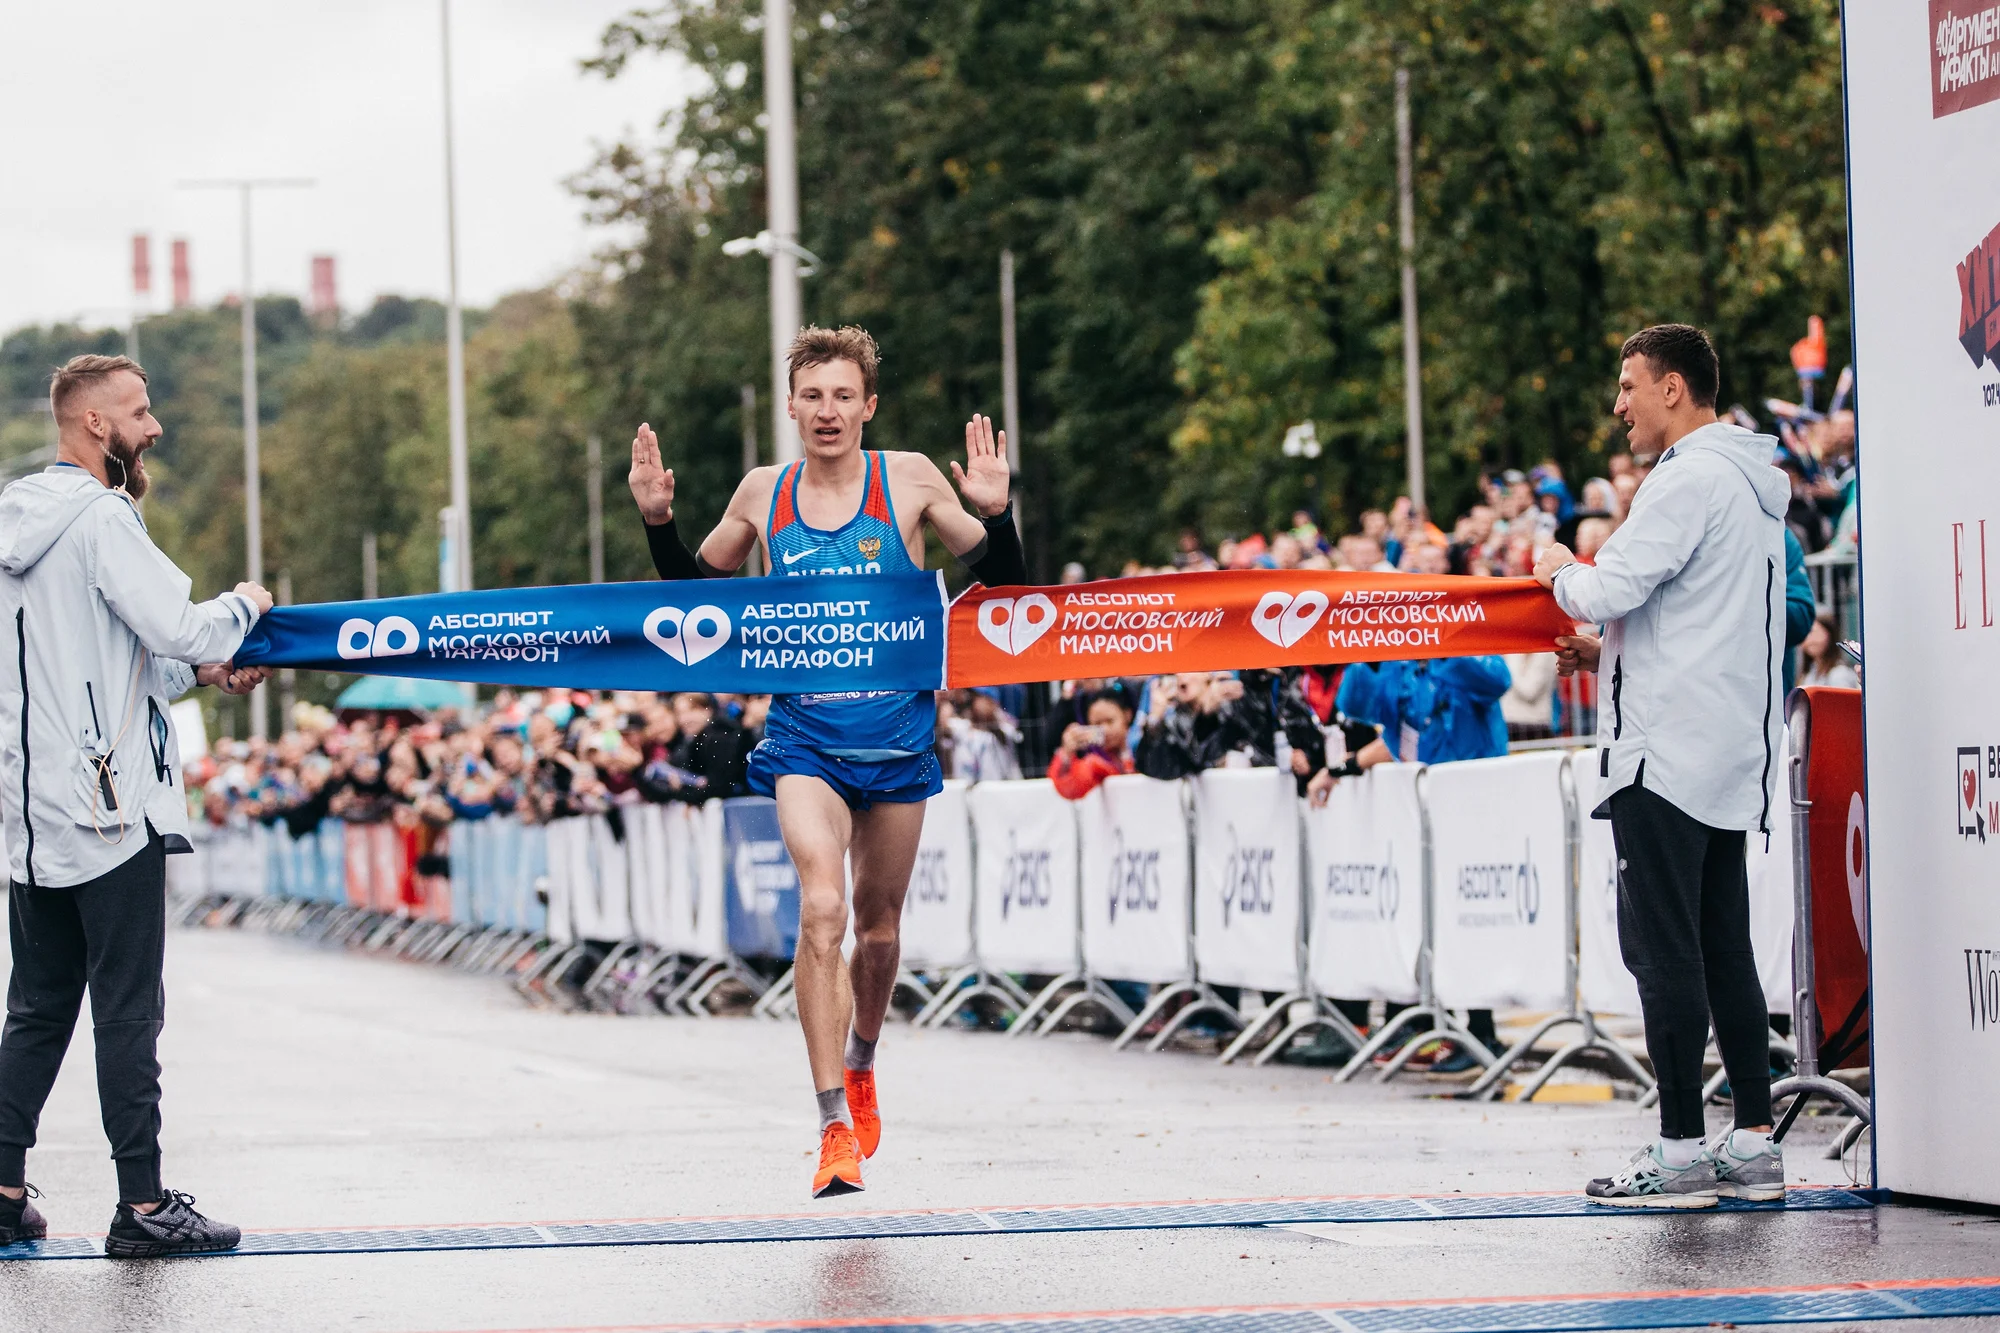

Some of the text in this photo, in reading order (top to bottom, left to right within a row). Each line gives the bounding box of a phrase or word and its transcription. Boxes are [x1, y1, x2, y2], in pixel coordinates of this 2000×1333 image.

[1064, 592, 1176, 606] АБСОЛЮТ
[1339, 590, 1447, 604] АБСОЛЮТ
[428, 610, 554, 630] АБСОЛЮТ
[742, 600, 871, 620] АБСОЛЮТ
[1062, 607, 1225, 631] МОСКОВСКИЙ
[1328, 600, 1486, 625] МОСКОВСКИЙ
[428, 625, 611, 652] МОСКОВСКИЙ
[741, 615, 925, 645] МОСКОВСКИЙ
[1328, 627, 1440, 648] МАРАФОН
[1060, 632, 1173, 655] МАРАФОН
[741, 647, 874, 669] МАРАФОН
[1964, 949, 2000, 1032] Wo
